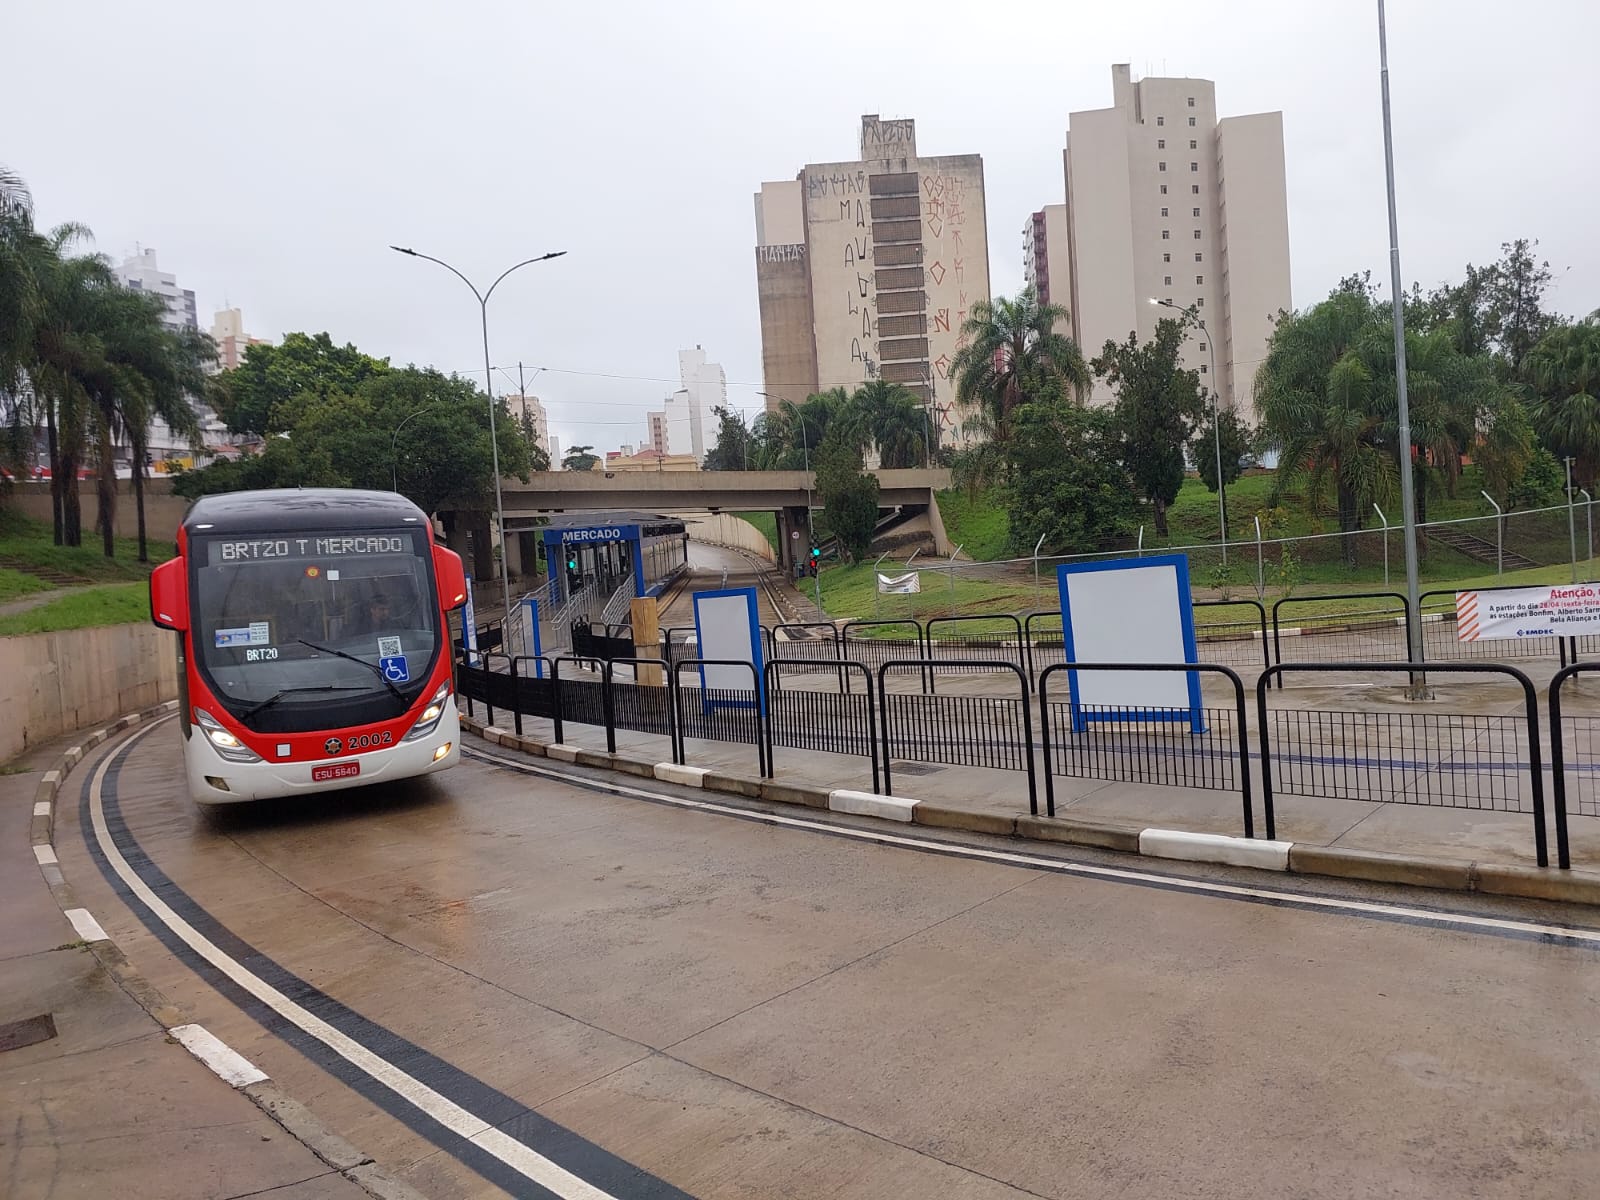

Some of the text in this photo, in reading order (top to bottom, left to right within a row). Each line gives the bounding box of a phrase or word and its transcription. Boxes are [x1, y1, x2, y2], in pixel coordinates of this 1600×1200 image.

[562, 528, 621, 541] MERCADO
[295, 539, 309, 556] T
[315, 537, 403, 555] MERCADO
[1550, 586, 1596, 600] Atenção,
[1495, 604, 1515, 613] partir
[1516, 603, 1527, 611] do
[1527, 602, 1539, 610] dia
[1498, 610, 1528, 620] estações
[1528, 608, 1556, 618] Bonfim,
[1557, 607, 1584, 616] Alberto
[1550, 616, 1565, 624] Bela
[1566, 615, 1592, 623] Aliança
[246, 647, 279, 662] BRT20
[348, 731, 392, 750] 2002
